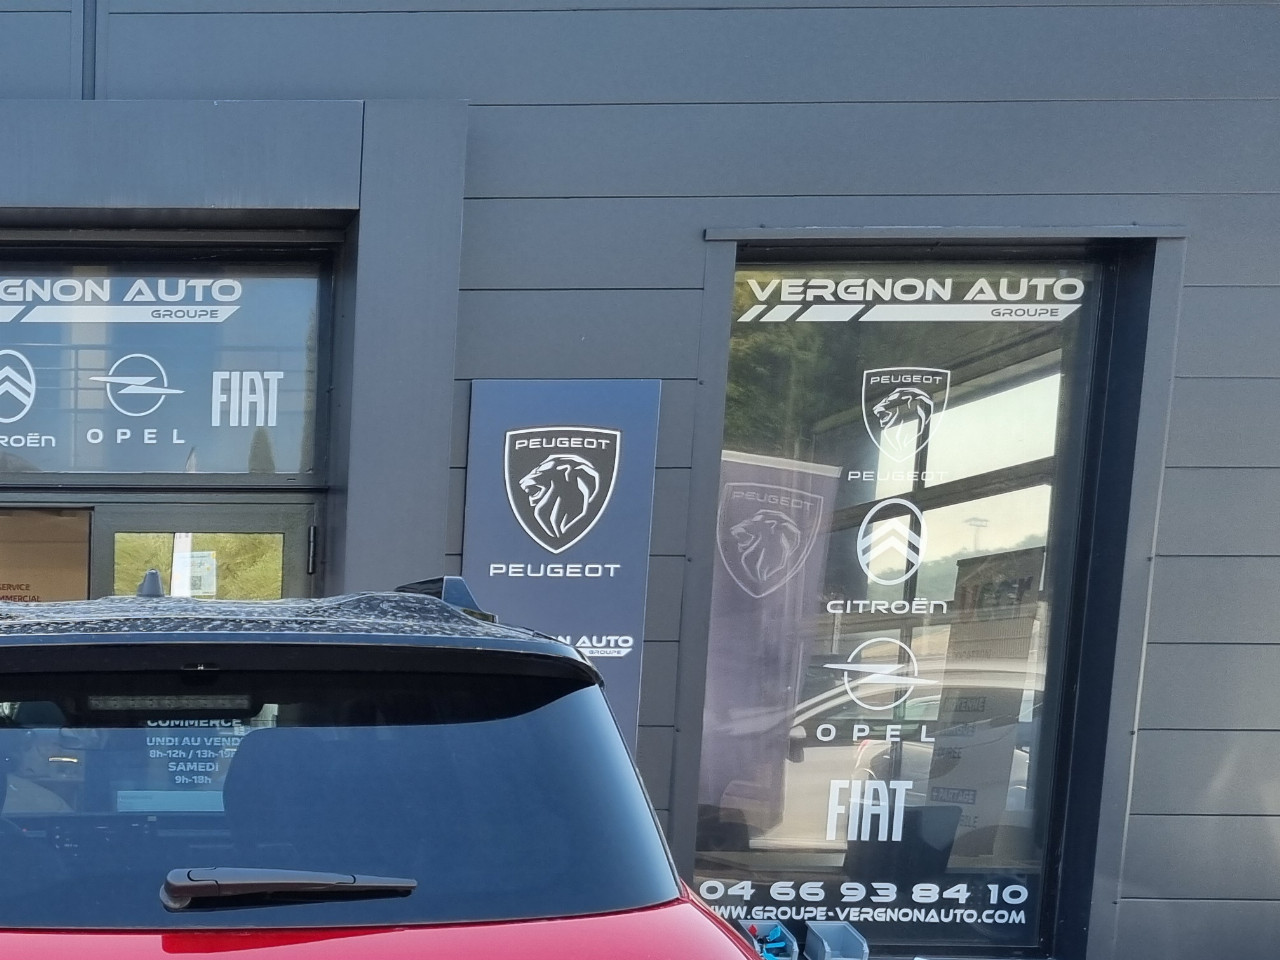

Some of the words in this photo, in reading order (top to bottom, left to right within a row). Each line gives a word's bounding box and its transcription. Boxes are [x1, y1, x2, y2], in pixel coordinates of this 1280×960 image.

[122, 279, 242, 302] AUTO
[747, 278, 951, 301] VERGNON
[962, 277, 1085, 301] AUTO
[151, 309, 220, 319] GROUPE
[991, 307, 1060, 318] GROUPE
[870, 374, 943, 385] PEUGEOT
[211, 371, 284, 427] FIAT
[86, 428, 185, 444] OPEL
[515, 437, 610, 450] PEUGEOT
[848, 471, 948, 481] PEUGEOT
[733, 491, 814, 511] PEUGEOT
[489, 564, 622, 577] PEUGEOT
[575, 635, 634, 648] AUTO
[816, 724, 935, 742] OPEL
[146, 737, 179, 746] UNDI
[181, 737, 200, 746] AU
[204, 737, 244, 746] VEND
[149, 750, 185, 758] 8h-12h
[168, 762, 219, 772] SAMEDI
[175, 775, 212, 784] 9h-18h
[826, 780, 912, 841] FIAT
[699, 880, 756, 901] 04
[769, 881, 826, 901] 66
[840, 882, 897, 903] 93
[912, 883, 971, 904] 84
[987, 884, 1028, 904] 10
[710, 905, 1026, 924] WW.GROUPE-VERGNONAUTO.COM
